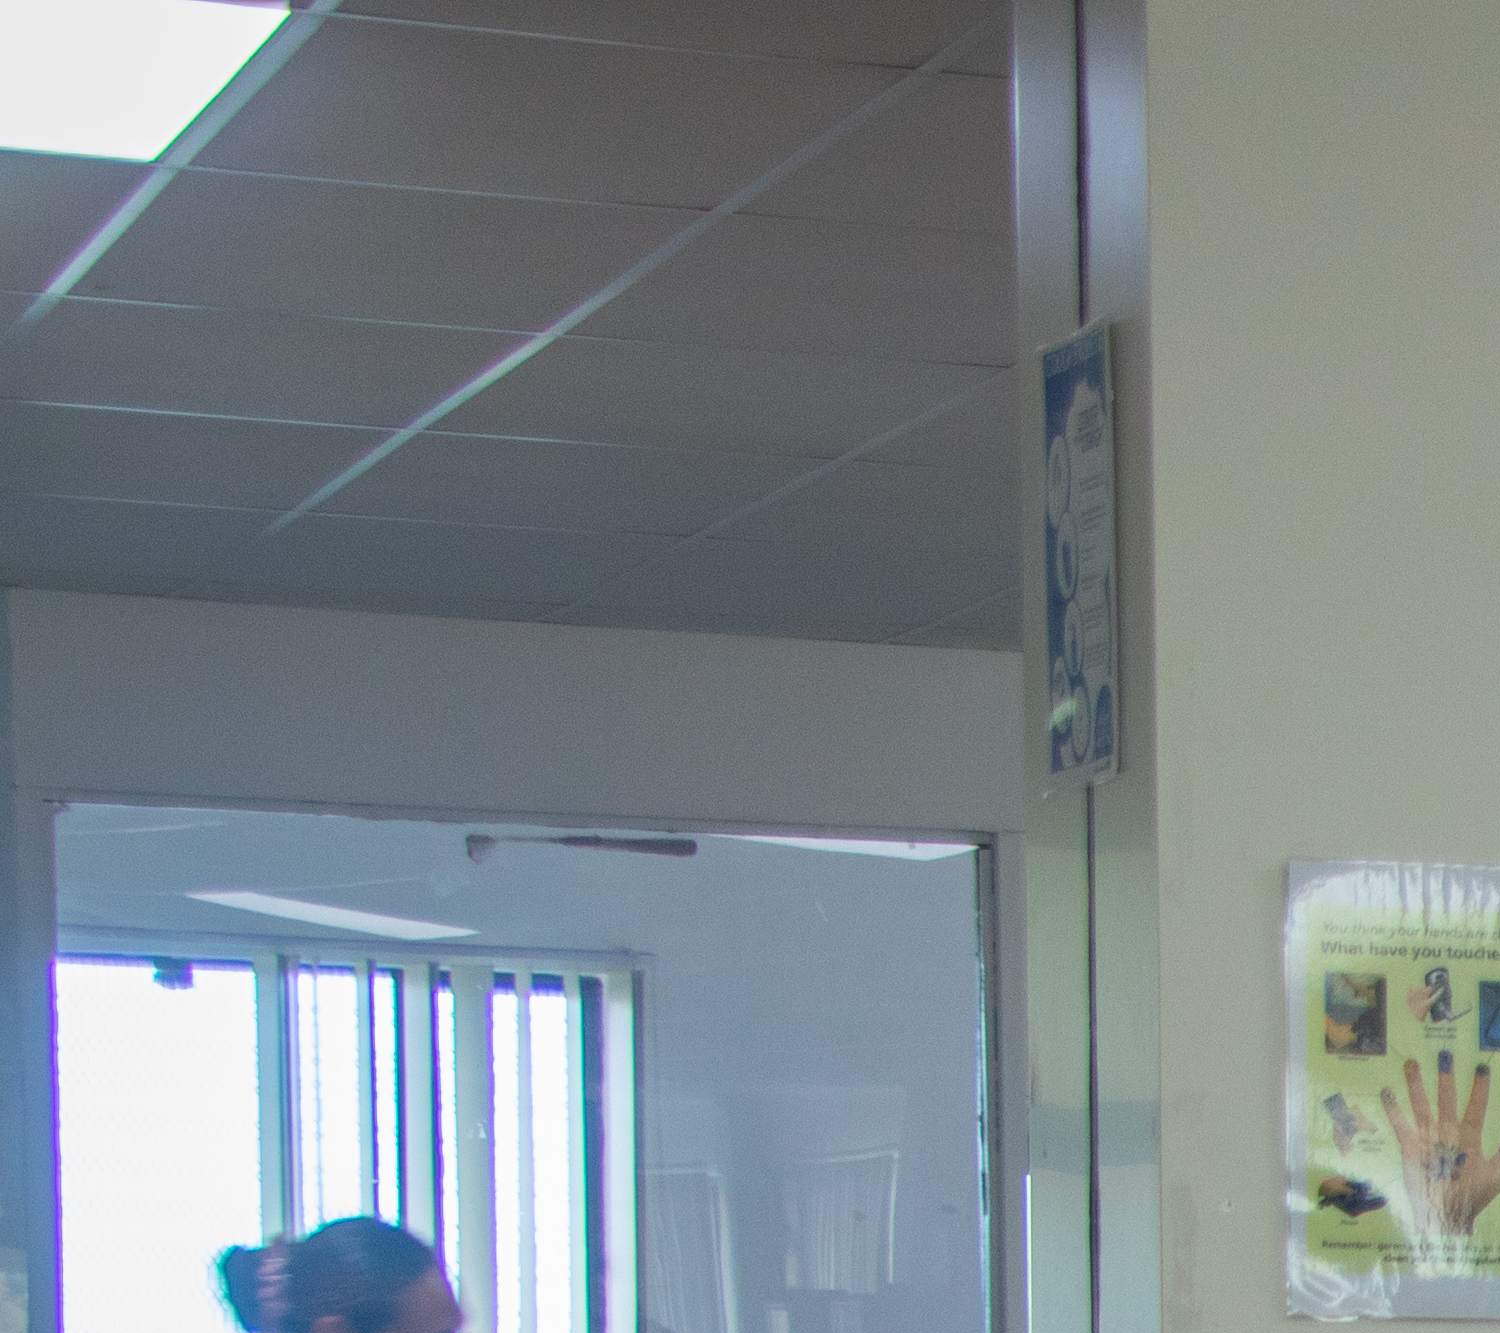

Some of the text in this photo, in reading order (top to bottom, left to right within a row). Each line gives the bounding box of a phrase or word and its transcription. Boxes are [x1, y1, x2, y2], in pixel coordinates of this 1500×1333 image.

[1321, 940, 1364, 956] What
[1369, 941, 1408, 957] have
[1412, 946, 1442, 962] you
